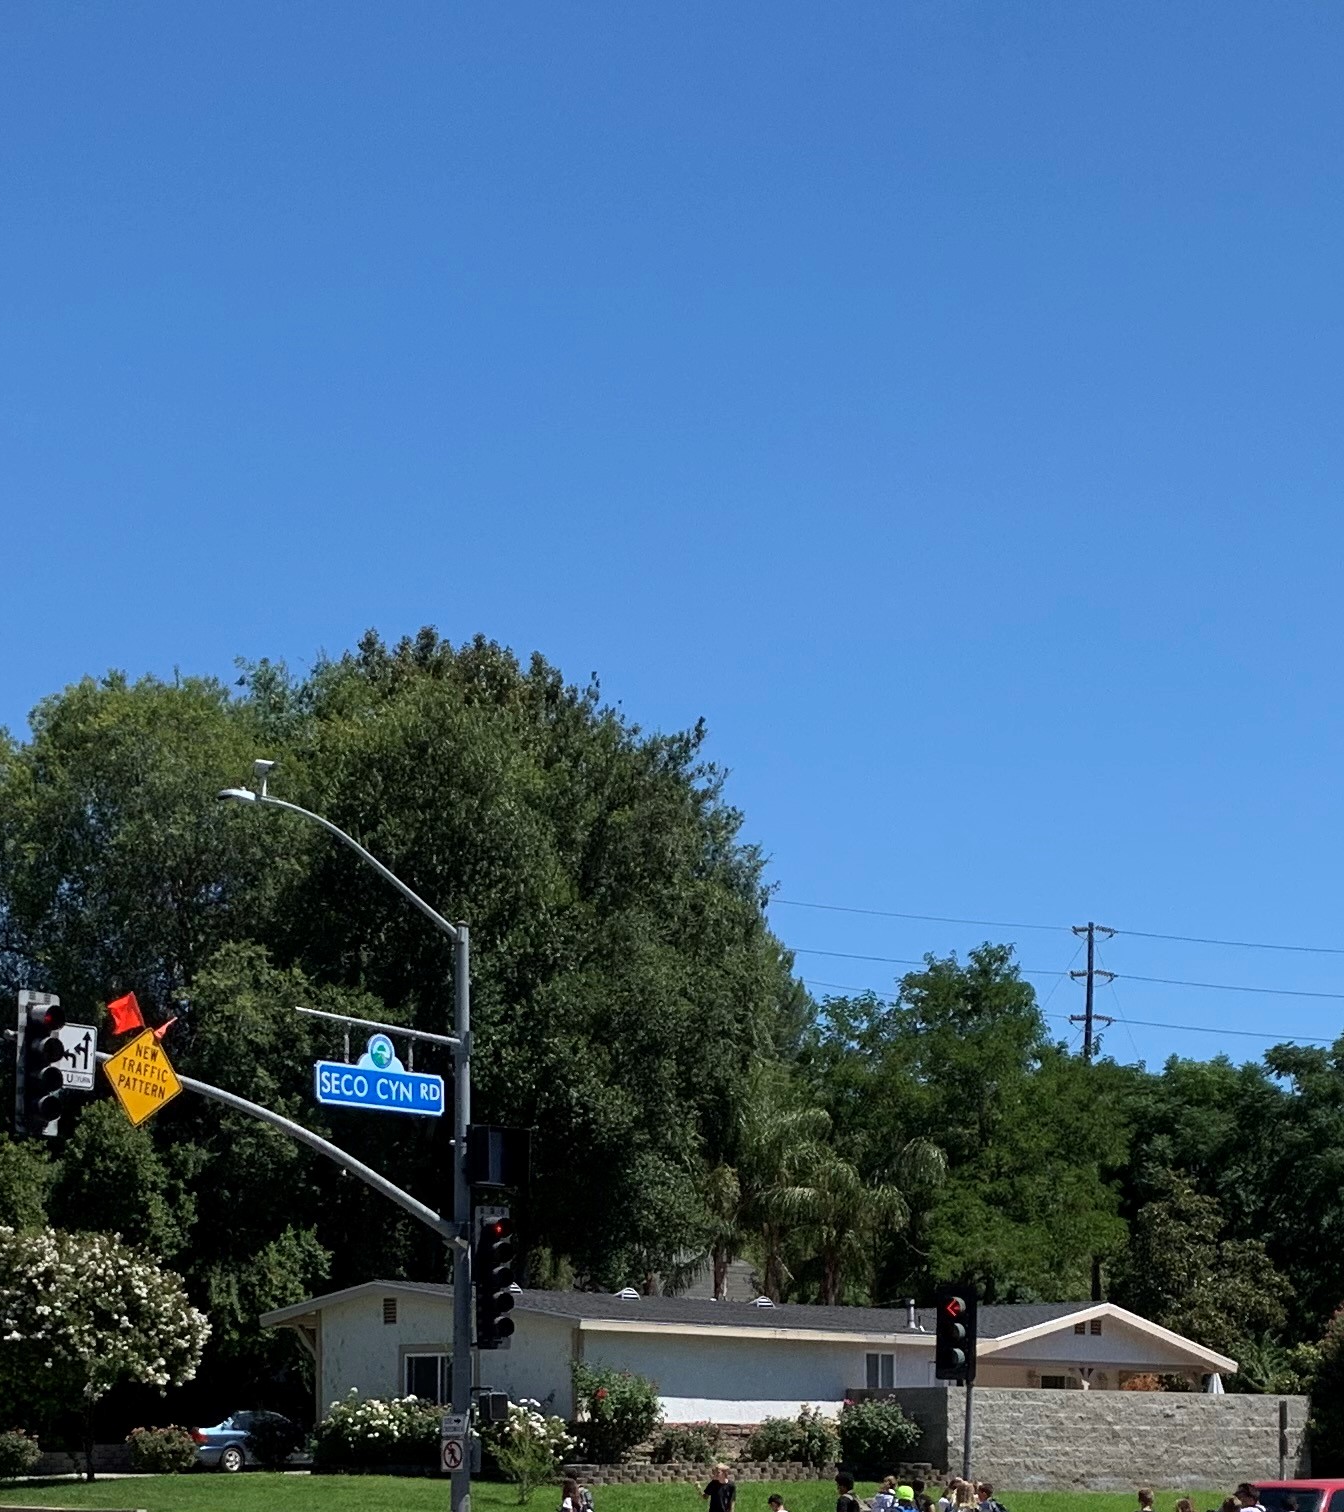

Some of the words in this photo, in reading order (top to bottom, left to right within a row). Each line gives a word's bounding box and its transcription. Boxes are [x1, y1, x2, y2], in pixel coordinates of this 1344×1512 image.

[135, 1042, 159, 1063] NEW
[121, 1056, 169, 1083] TRAFFIC
[116, 1072, 167, 1100] PATTERN
[320, 1070, 369, 1098] SECO
[375, 1077, 414, 1102] CYN
[419, 1082, 441, 1101] RD
